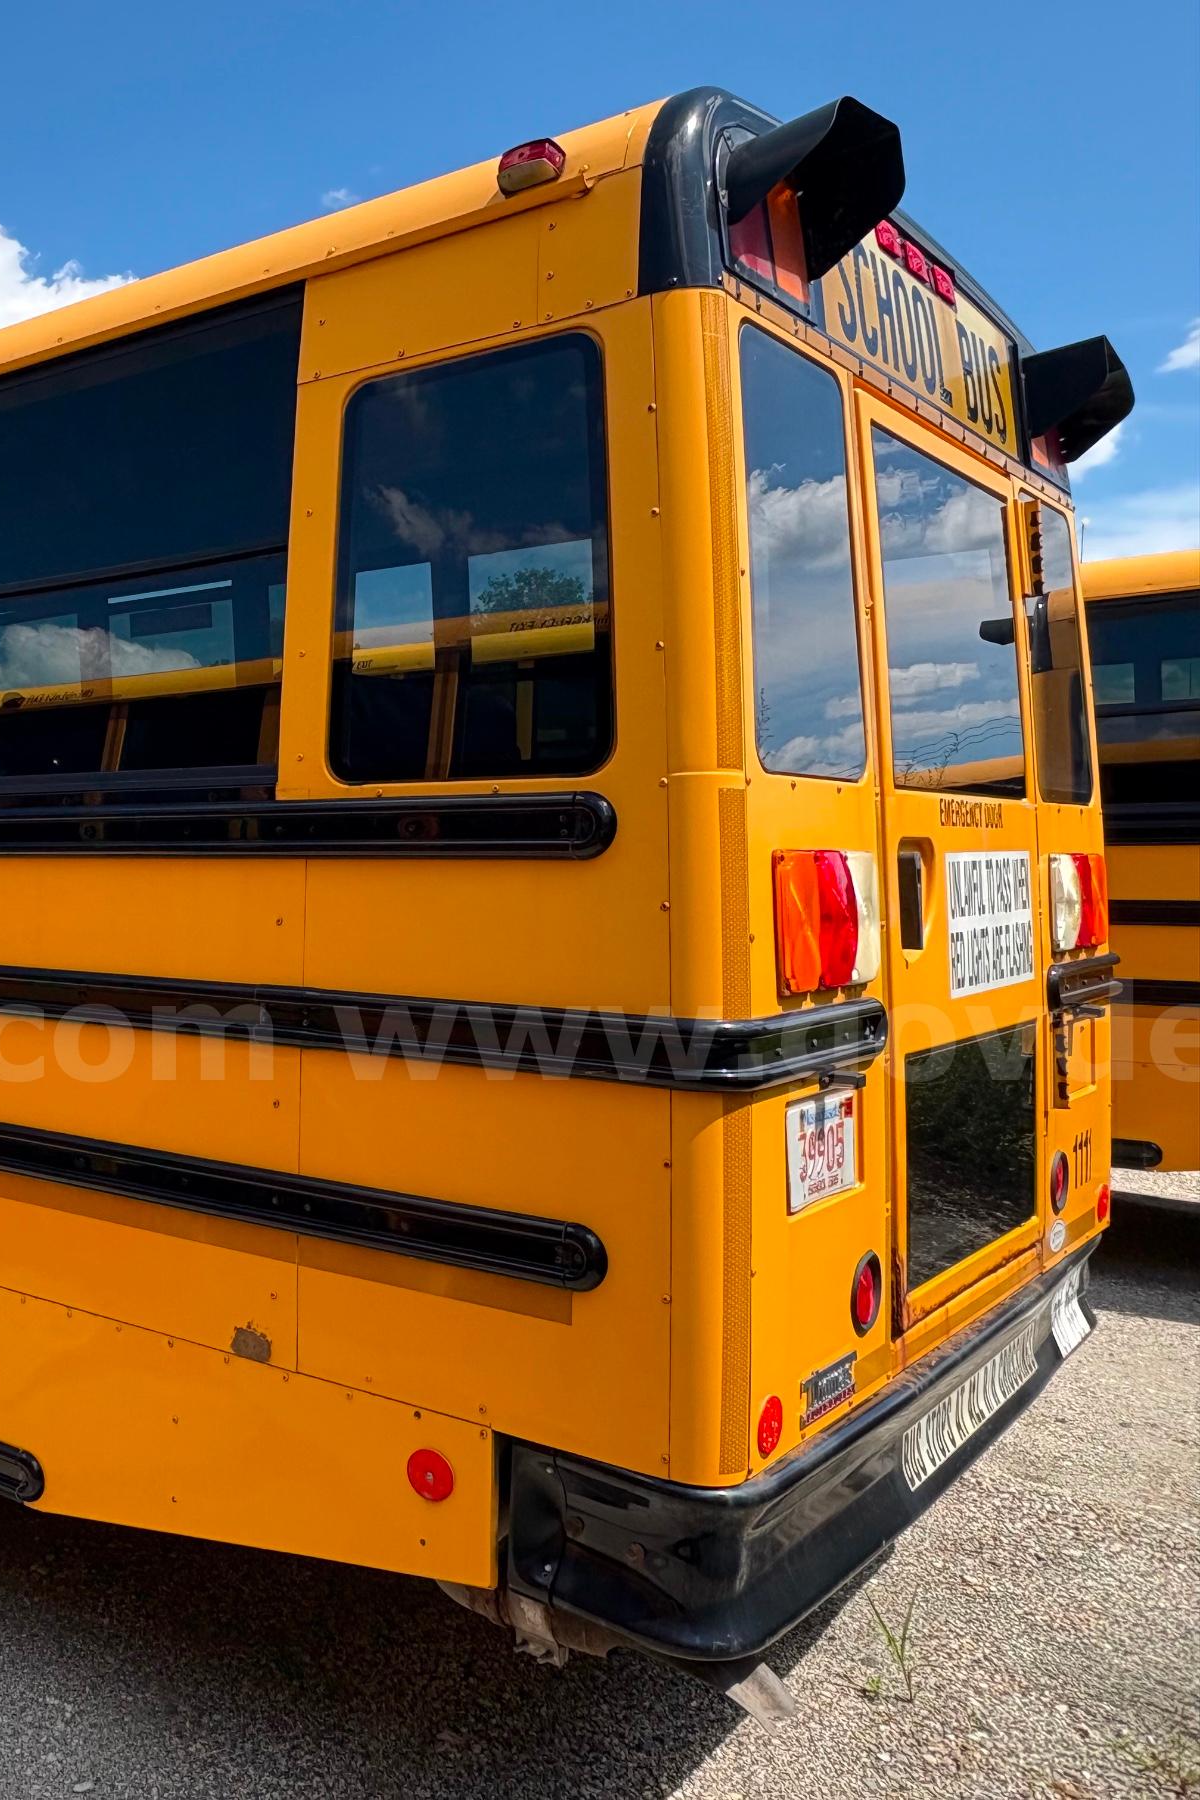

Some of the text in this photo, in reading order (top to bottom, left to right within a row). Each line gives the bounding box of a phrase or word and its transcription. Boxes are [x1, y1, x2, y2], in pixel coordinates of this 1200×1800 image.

[837, 242, 1007, 444] SCHOOL BUS
[940, 798, 982, 828] EMERGENCY
[948, 860, 985, 919] UNLAWFUL
[985, 858, 995, 915] TO
[996, 857, 1011, 914] PASS
[950, 920, 1033, 990] RED LIGHTS ARE FLASHING
[903, 1420, 927, 1489] BUS
[926, 1397, 957, 1467] STOPS
[955, 1384, 970, 1441] AT
